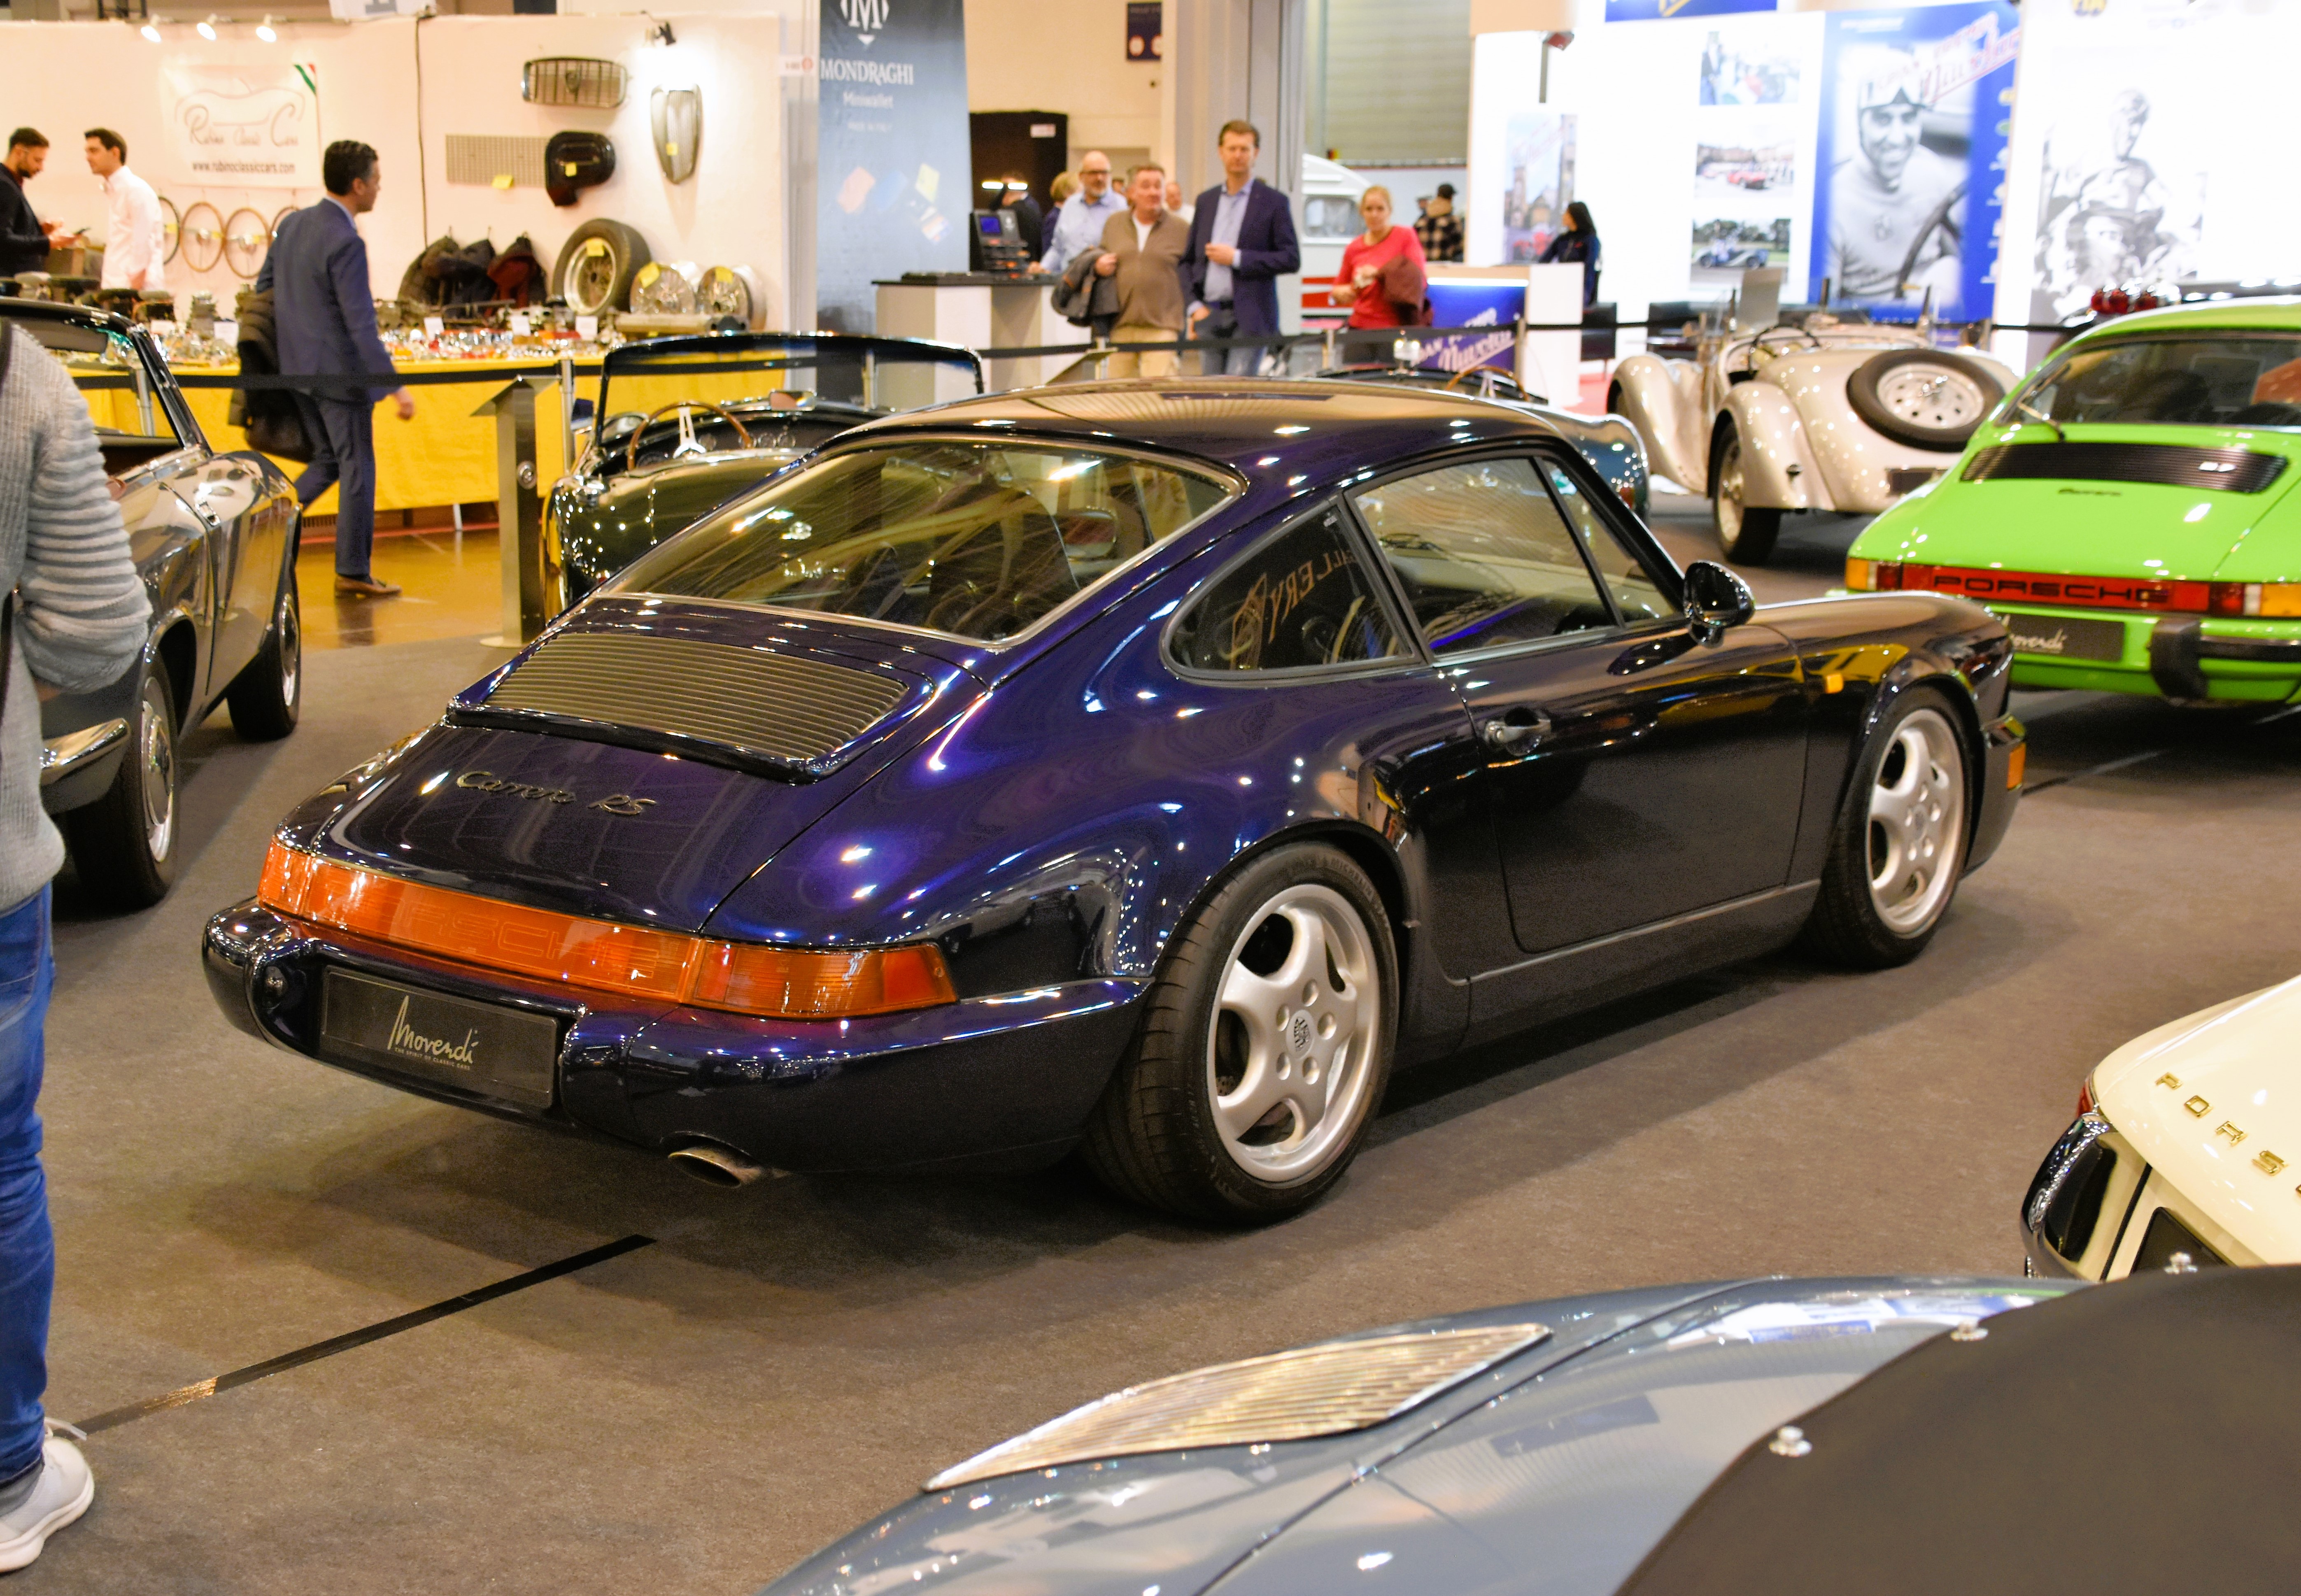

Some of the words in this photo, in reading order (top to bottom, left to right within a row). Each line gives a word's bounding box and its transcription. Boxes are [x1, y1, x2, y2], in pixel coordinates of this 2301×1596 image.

[820, 58, 914, 86] MONDRAGHI
[1934, 575, 2170, 603] PORSCHE
[2001, 614, 2068, 650] ovendi
[456, 770, 576, 804] Carrera
[588, 794, 657, 816] RS
[387, 995, 479, 1064] Movendi
[2154, 1072, 2301, 1197] PORS
